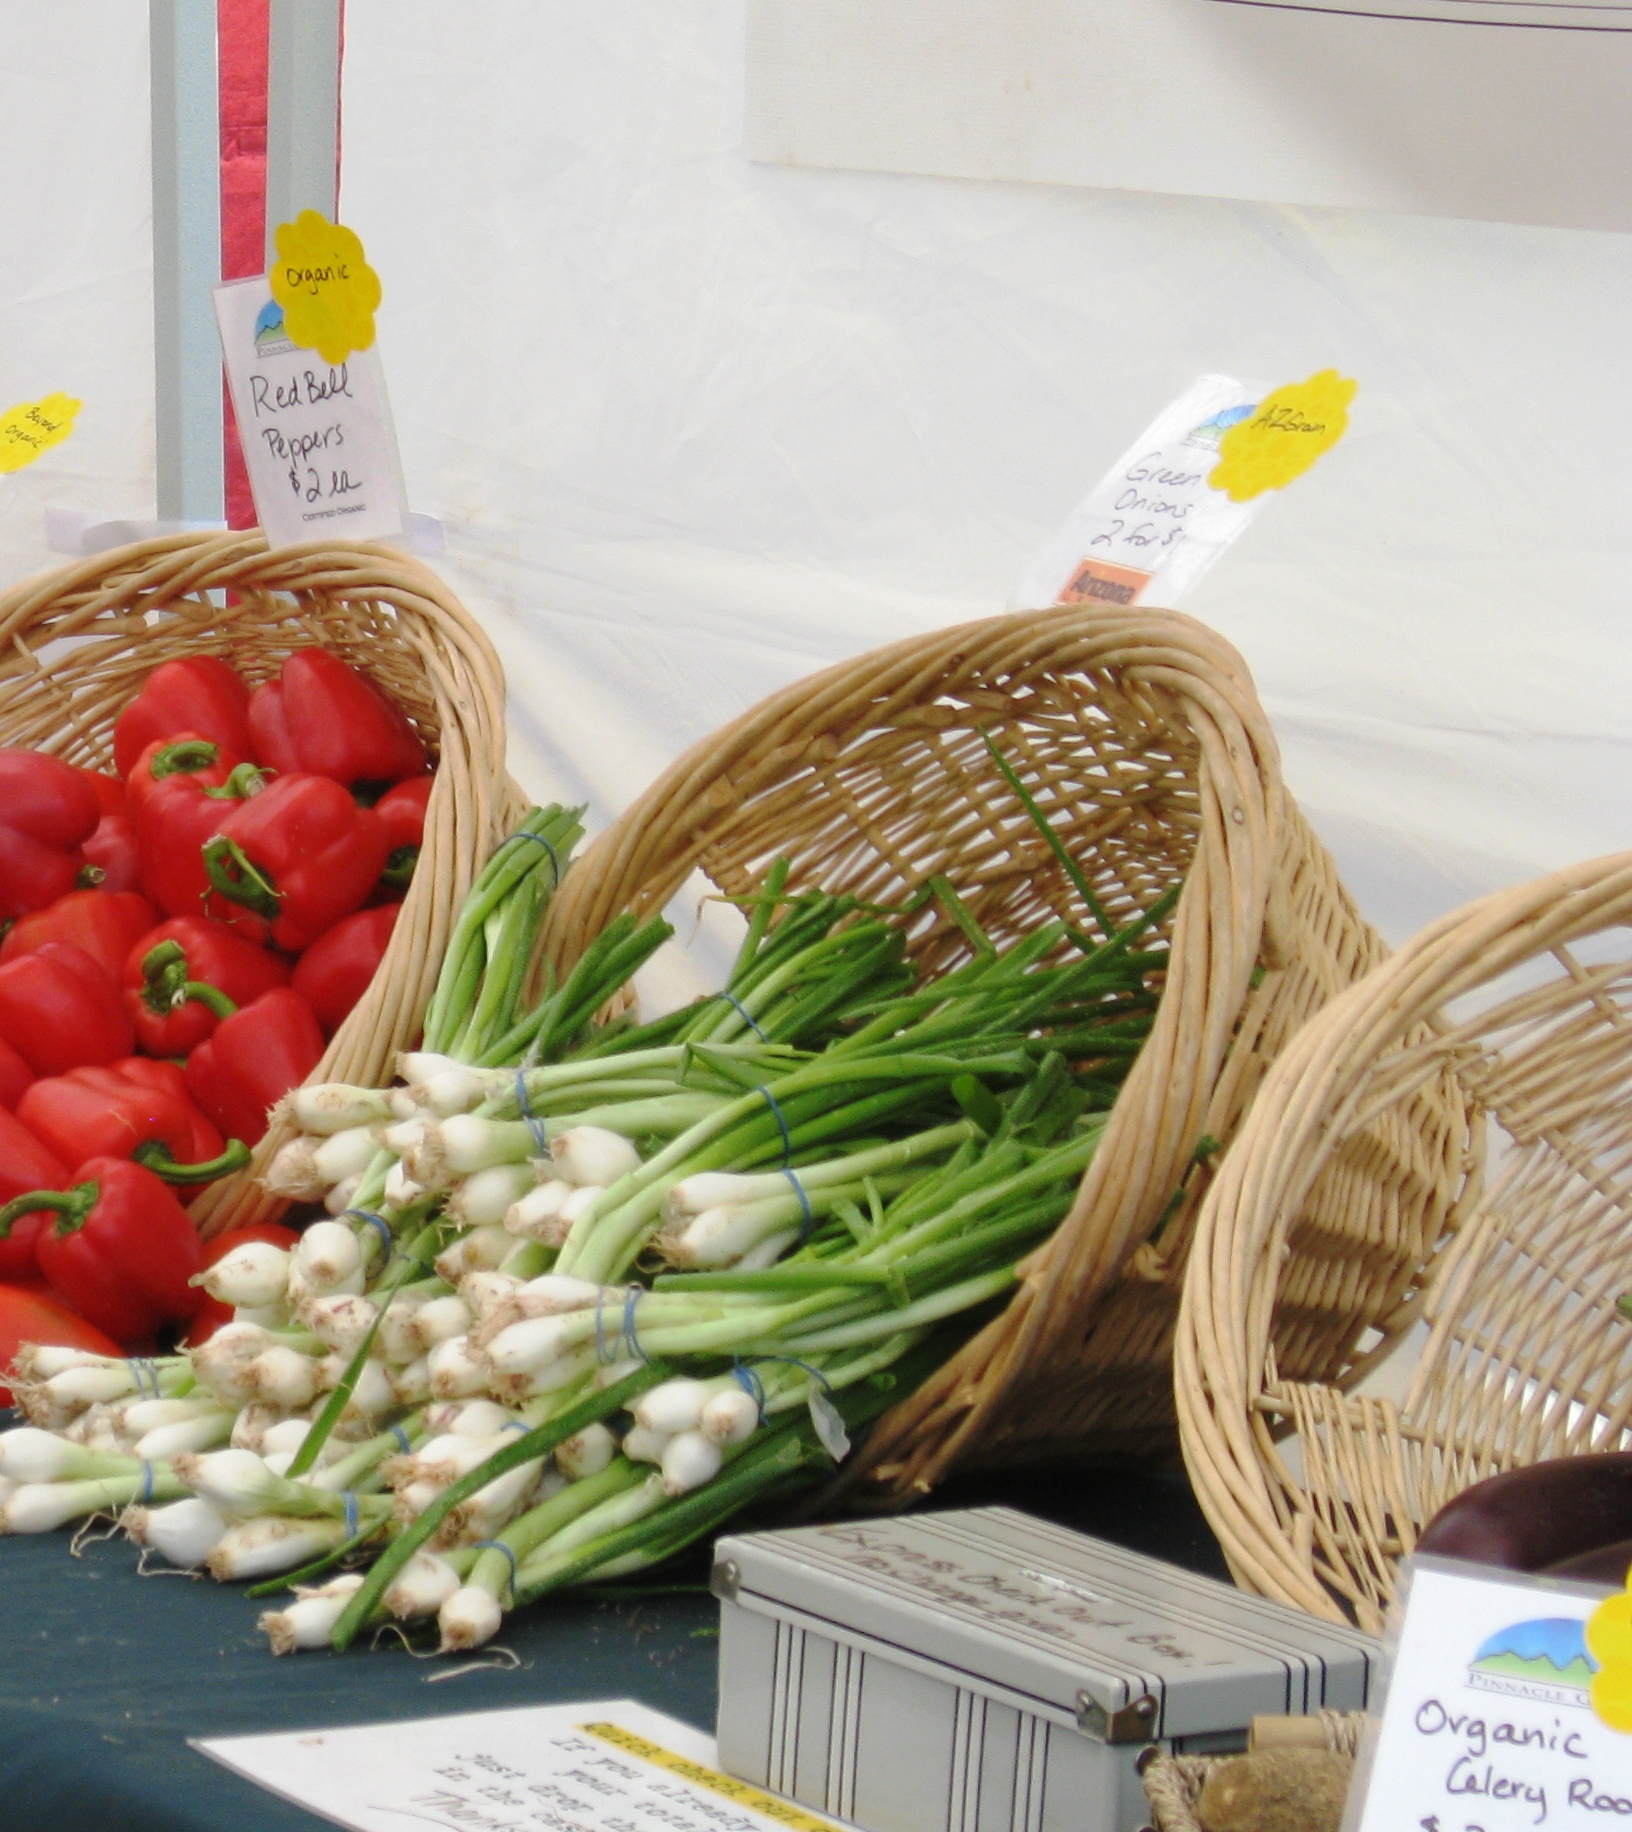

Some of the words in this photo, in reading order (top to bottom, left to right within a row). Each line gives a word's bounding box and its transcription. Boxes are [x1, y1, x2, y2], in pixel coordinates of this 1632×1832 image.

[249, 374, 299, 416] Red
[304, 363, 353, 405] Bell
[25, 407, 61, 433] Beyond
[262, 423, 344, 467] Peppers
[329, 469, 363, 497] ea
[1126, 451, 1202, 486] Green
[1114, 488, 1193, 518] Onions
[1090, 519, 1125, 547] 2
[1123, 522, 1160, 547] for
[1415, 1698, 1589, 1759] Organic
[455, 1753, 527, 1780] just
[528, 1784, 594, 1811] drop
[476, 1786, 525, 1806] the
[552, 1767, 628, 1796] your
[584, 1758, 643, 1780] you
[647, 1784, 762, 1832] already
[1446, 1755, 1548, 1826] Celery
[1567, 1777, 1632, 1816] Roo
